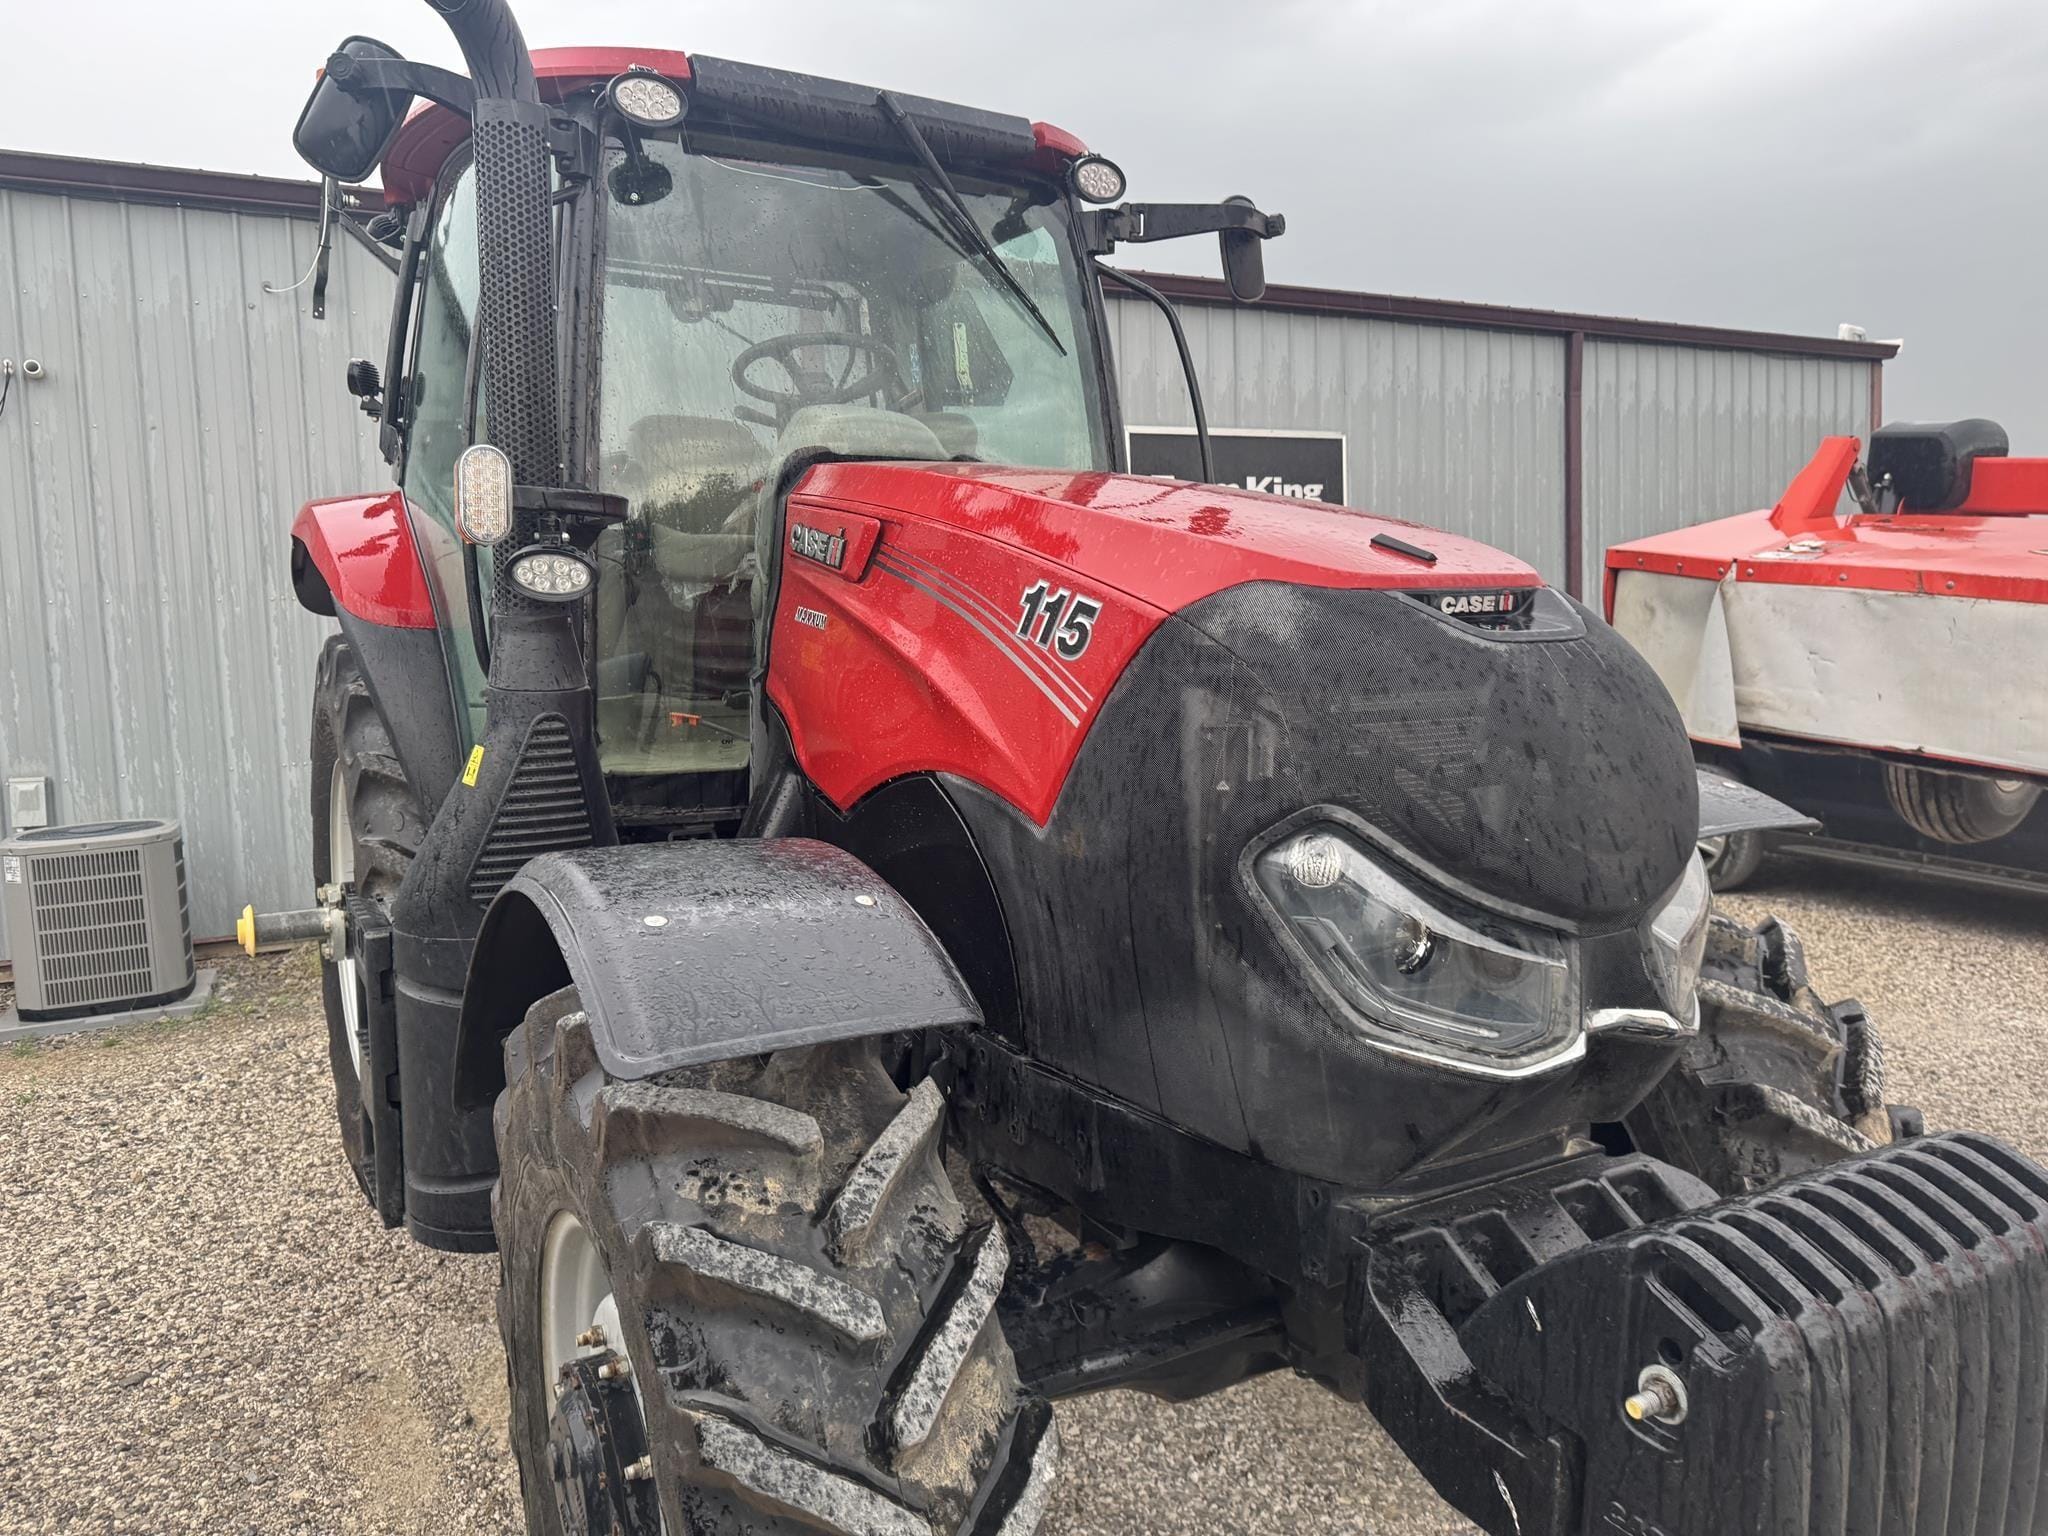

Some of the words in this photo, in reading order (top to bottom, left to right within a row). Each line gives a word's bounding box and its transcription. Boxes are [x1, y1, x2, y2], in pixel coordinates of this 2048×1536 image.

[1246, 475, 1323, 502] King
[791, 524, 829, 561] CASE
[1016, 579, 1103, 660] 115
[1441, 595, 1496, 615] CASE
